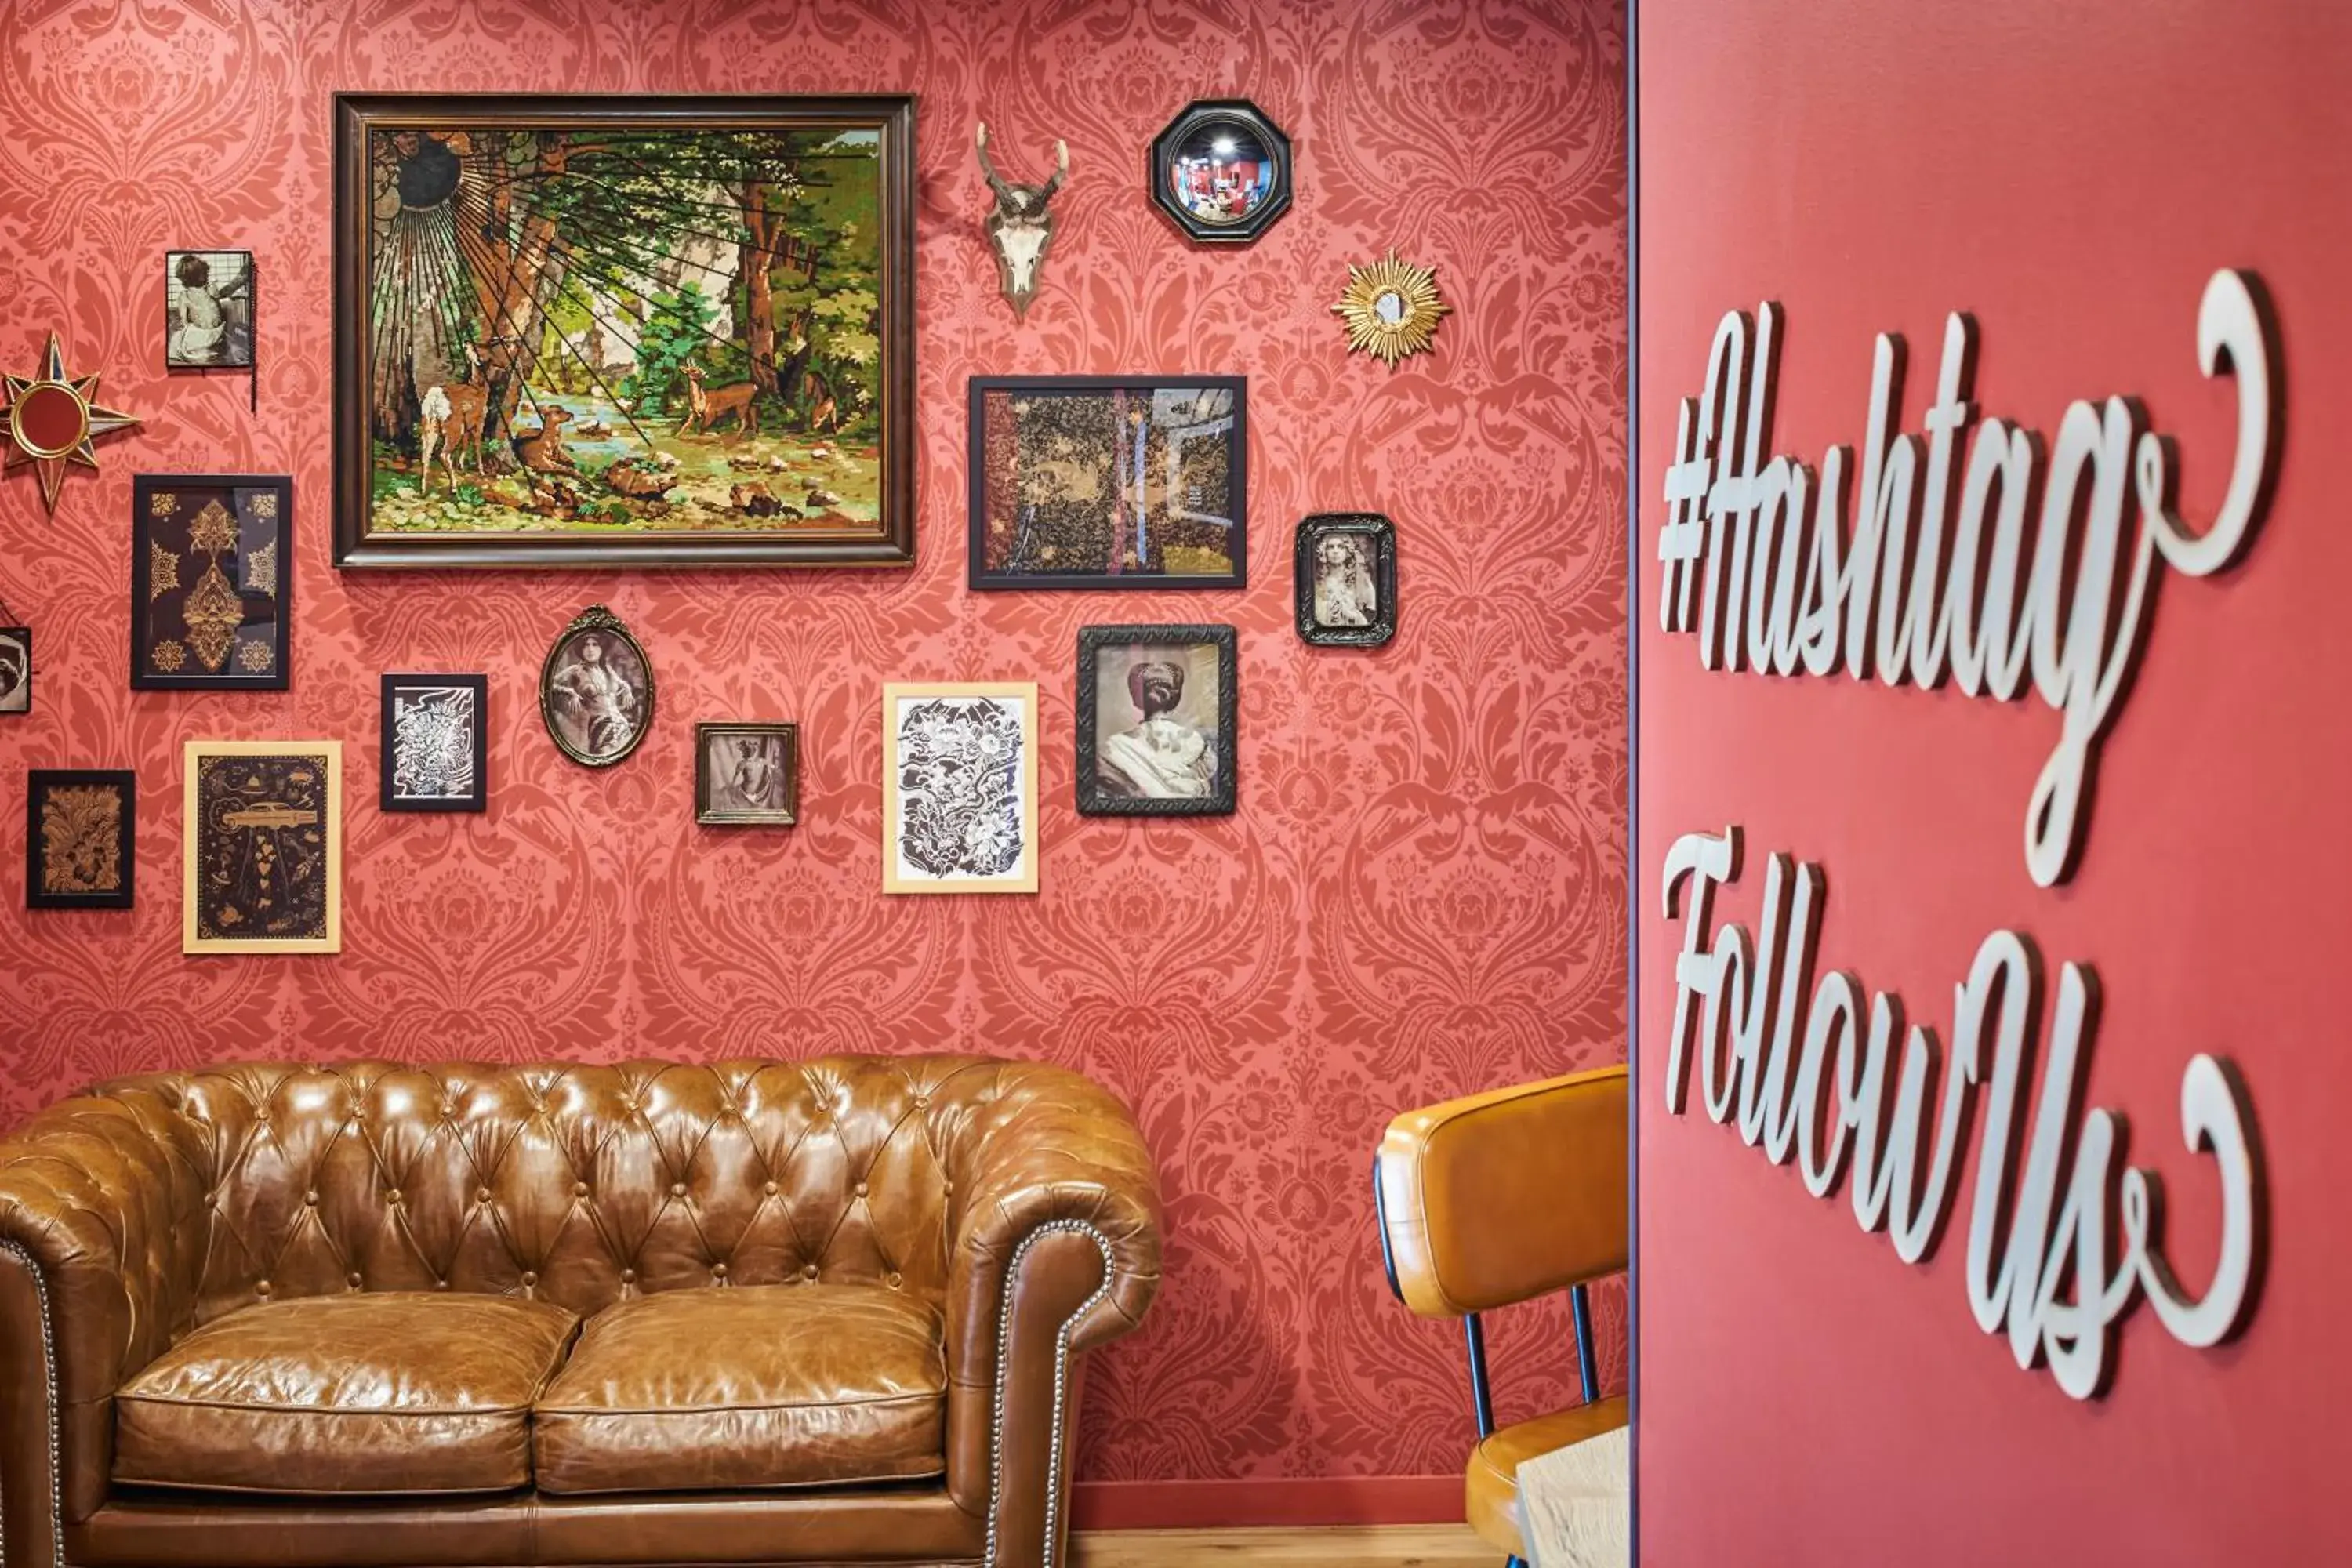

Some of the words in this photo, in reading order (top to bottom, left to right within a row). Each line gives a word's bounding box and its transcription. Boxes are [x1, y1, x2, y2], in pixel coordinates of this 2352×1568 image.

[1658, 268, 2278, 888] #Hashtag
[1662, 825, 1976, 1265] Follow
[1963, 929, 2259, 1400] Us
